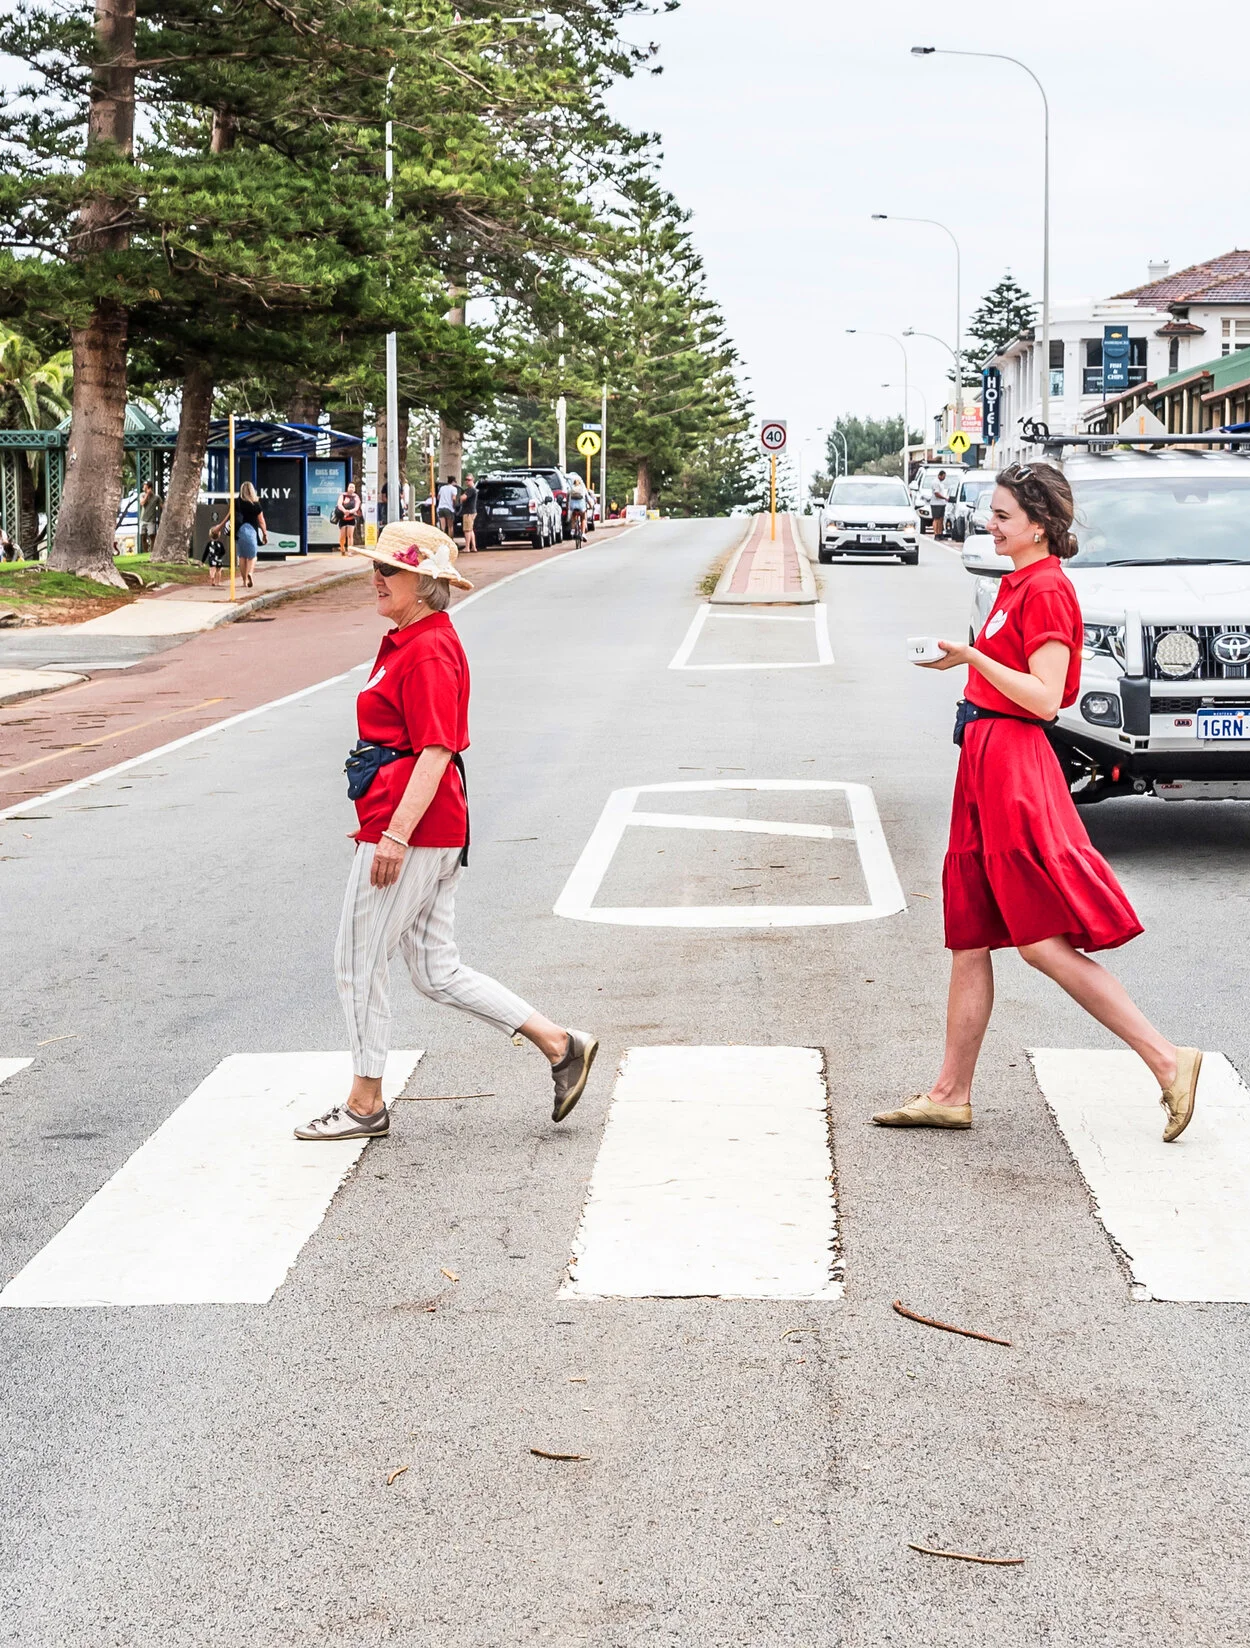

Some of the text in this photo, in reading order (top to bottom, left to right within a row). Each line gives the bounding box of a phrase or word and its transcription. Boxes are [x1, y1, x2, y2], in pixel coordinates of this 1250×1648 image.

[985, 376, 998, 437] HOTEL
[766, 430, 782, 442] 40
[260, 487, 292, 499] KNY
